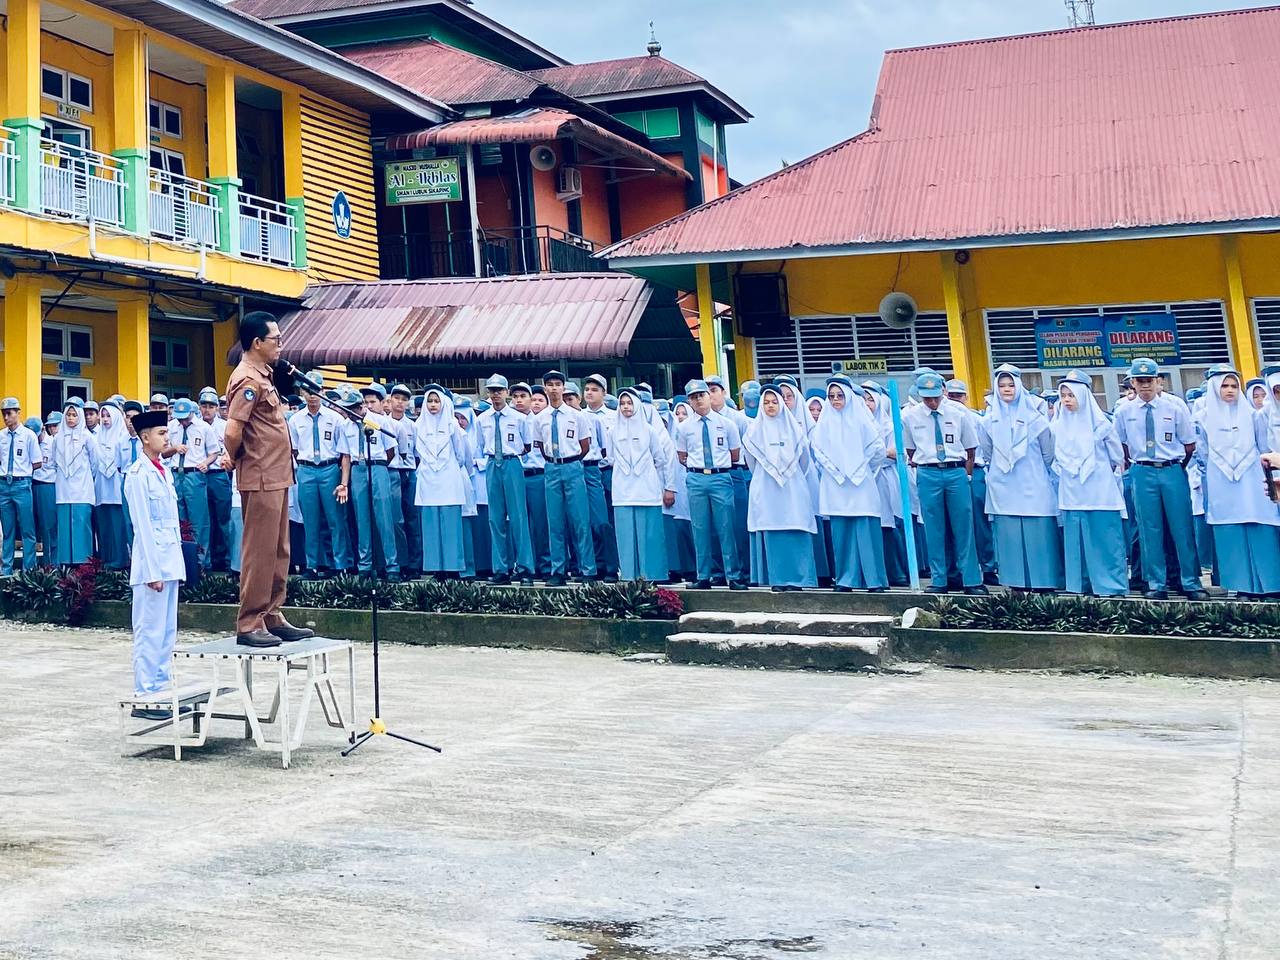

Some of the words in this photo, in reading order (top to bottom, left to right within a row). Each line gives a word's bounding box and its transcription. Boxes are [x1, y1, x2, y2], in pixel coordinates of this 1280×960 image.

[1109, 330, 1175, 345] DILARANG
[1043, 345, 1103, 358] DILARANG
[846, 362, 867, 371] LABOR
[868, 361, 879, 370] TIK
[880, 361, 885, 370] 2
